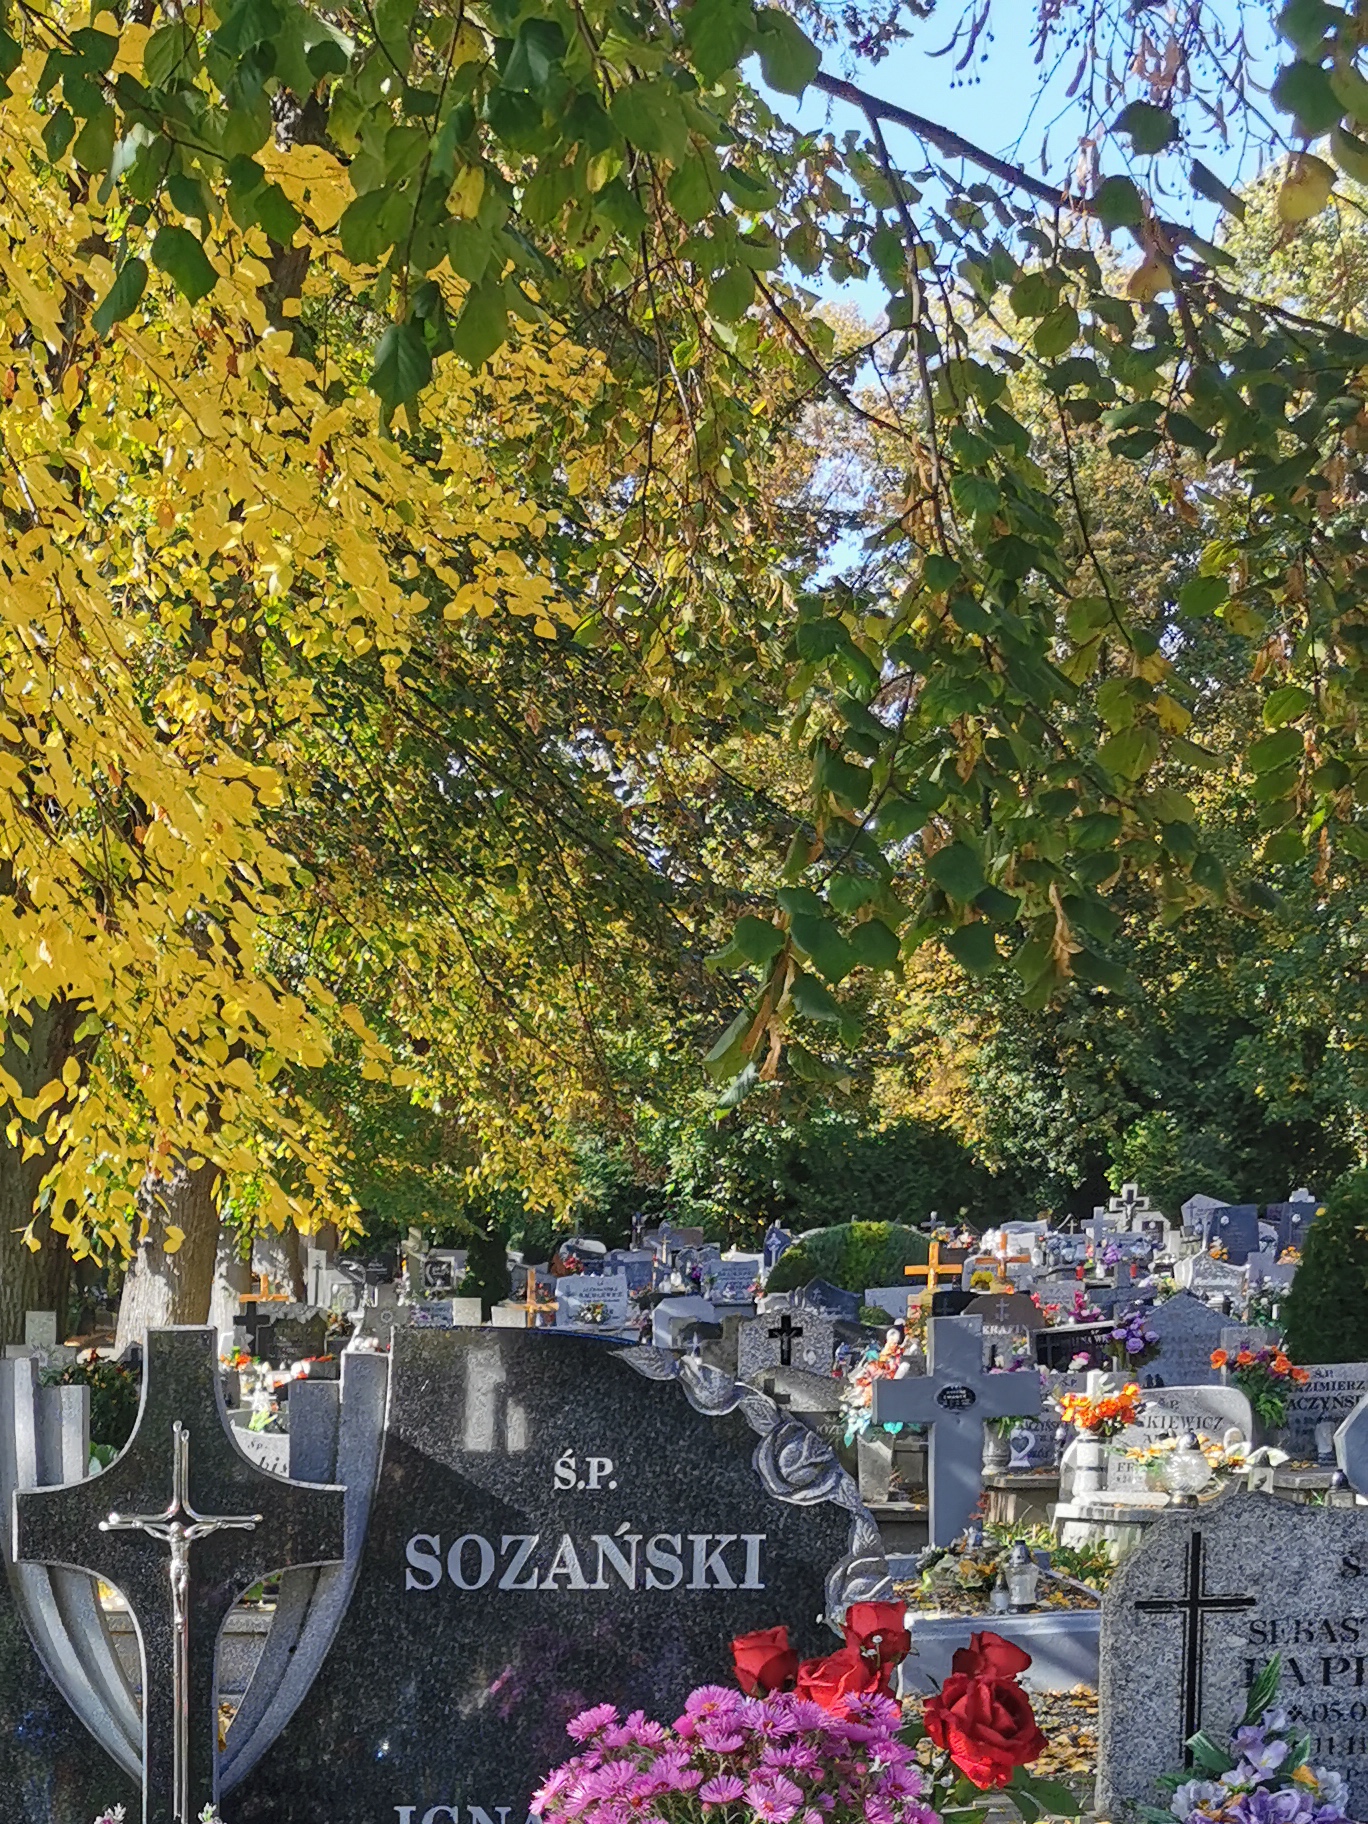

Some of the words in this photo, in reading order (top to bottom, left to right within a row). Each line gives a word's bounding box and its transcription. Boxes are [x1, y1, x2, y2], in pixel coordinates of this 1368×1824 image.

[554, 1448, 618, 1490] Ś.P.
[405, 1521, 767, 1591] SOZAŃSKI
[1248, 1616, 1368, 1645] SEBAS
